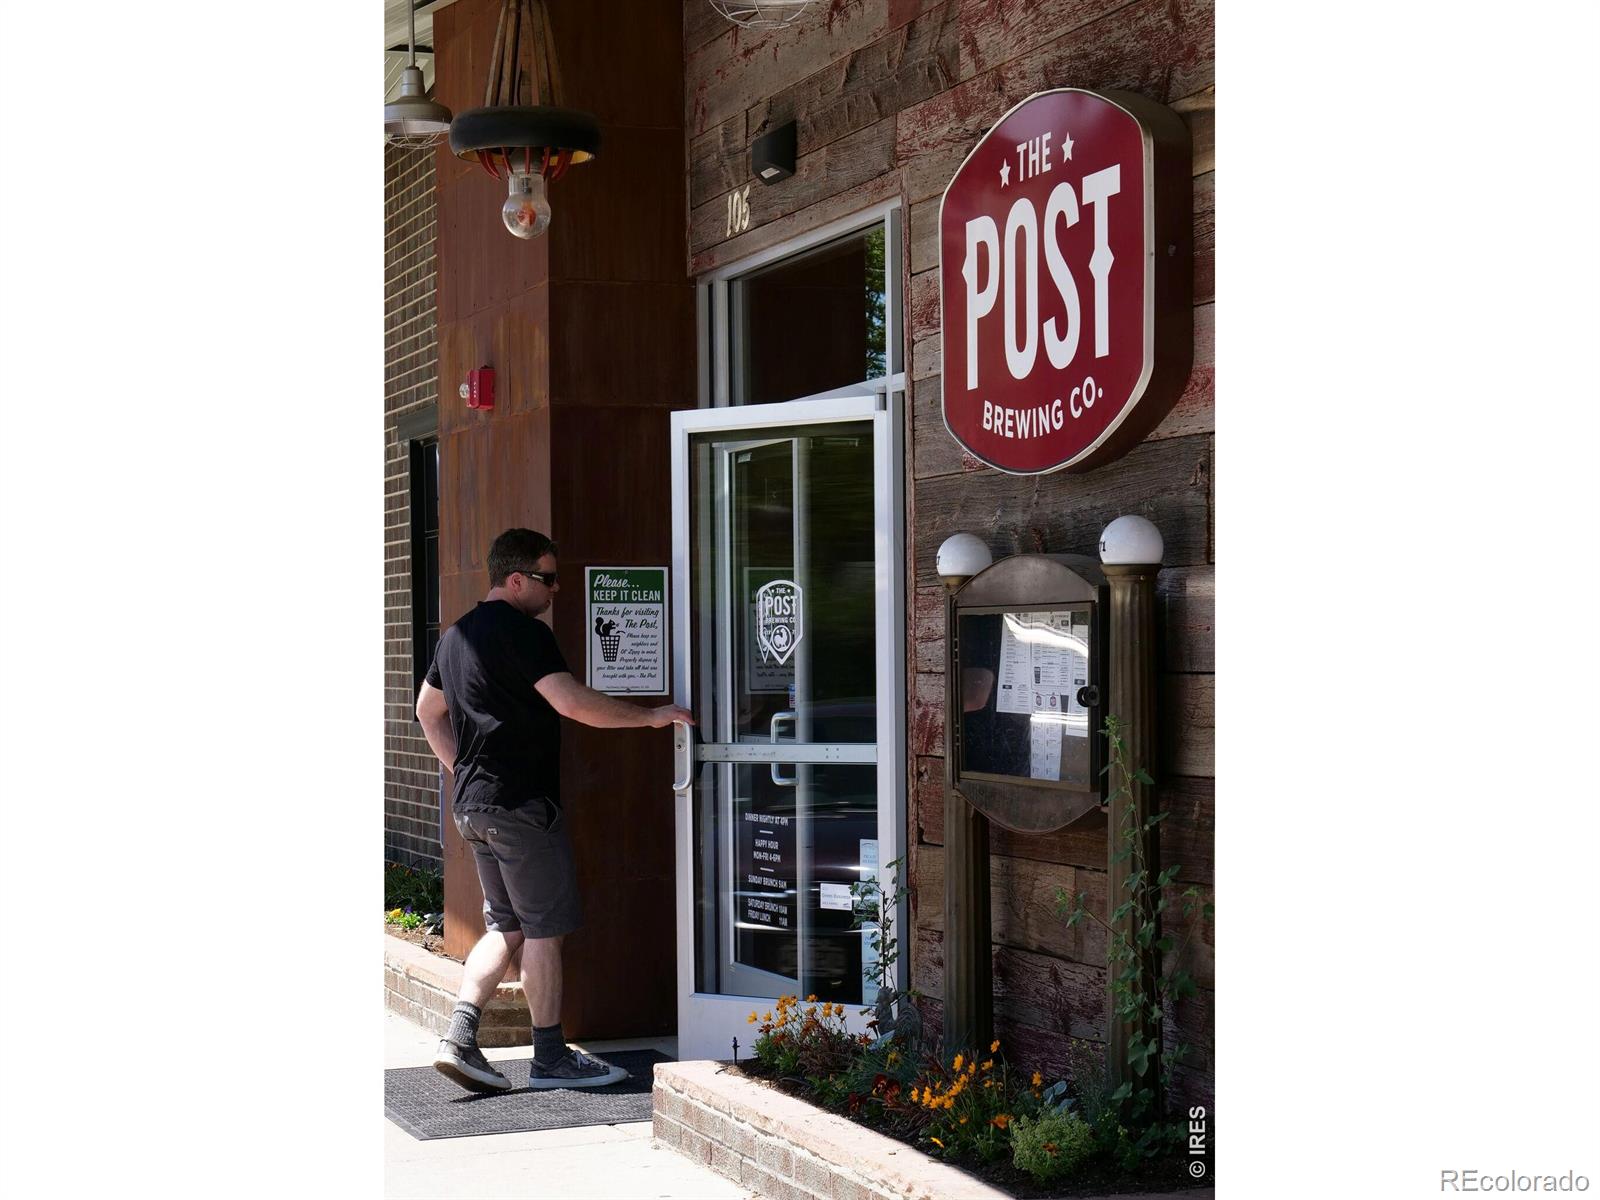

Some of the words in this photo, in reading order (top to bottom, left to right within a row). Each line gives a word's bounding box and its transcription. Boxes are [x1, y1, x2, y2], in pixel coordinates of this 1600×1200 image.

[1016, 131, 1052, 182] THE
[726, 185, 750, 237] 105
[961, 163, 1121, 391] POST
[982, 399, 1064, 439] BREWING
[1070, 376, 1103, 419] CO.
[593, 574, 640, 588] Please...
[593, 590, 617, 601] KEEP
[620, 590, 629, 601] IT
[631, 590, 661, 601] CLEAN
[596, 606, 620, 616] Thanks
[621, 606, 633, 618] for
[634, 607, 659, 618] visiting
[765, 596, 797, 616] POST
[625, 619, 638, 628] The
[640, 619, 658, 629] Post,
[745, 812, 759, 822] DINNER
[759, 814, 775, 824] NIGHTLY
[774, 816, 780, 825] AT
[755, 838, 768, 848] HAPPY
[767, 840, 779, 850] HOUR
[753, 851, 769, 861] MON-FRI
[748, 874, 763, 885] SUNDAY
[763, 877, 778, 888] BRUNCH
[748, 898, 765, 910] SATURDAY
[764, 901, 779, 912] BRUNCH
[748, 909, 760, 920] FRIDAY
[760, 912, 771, 922] LUNCH
